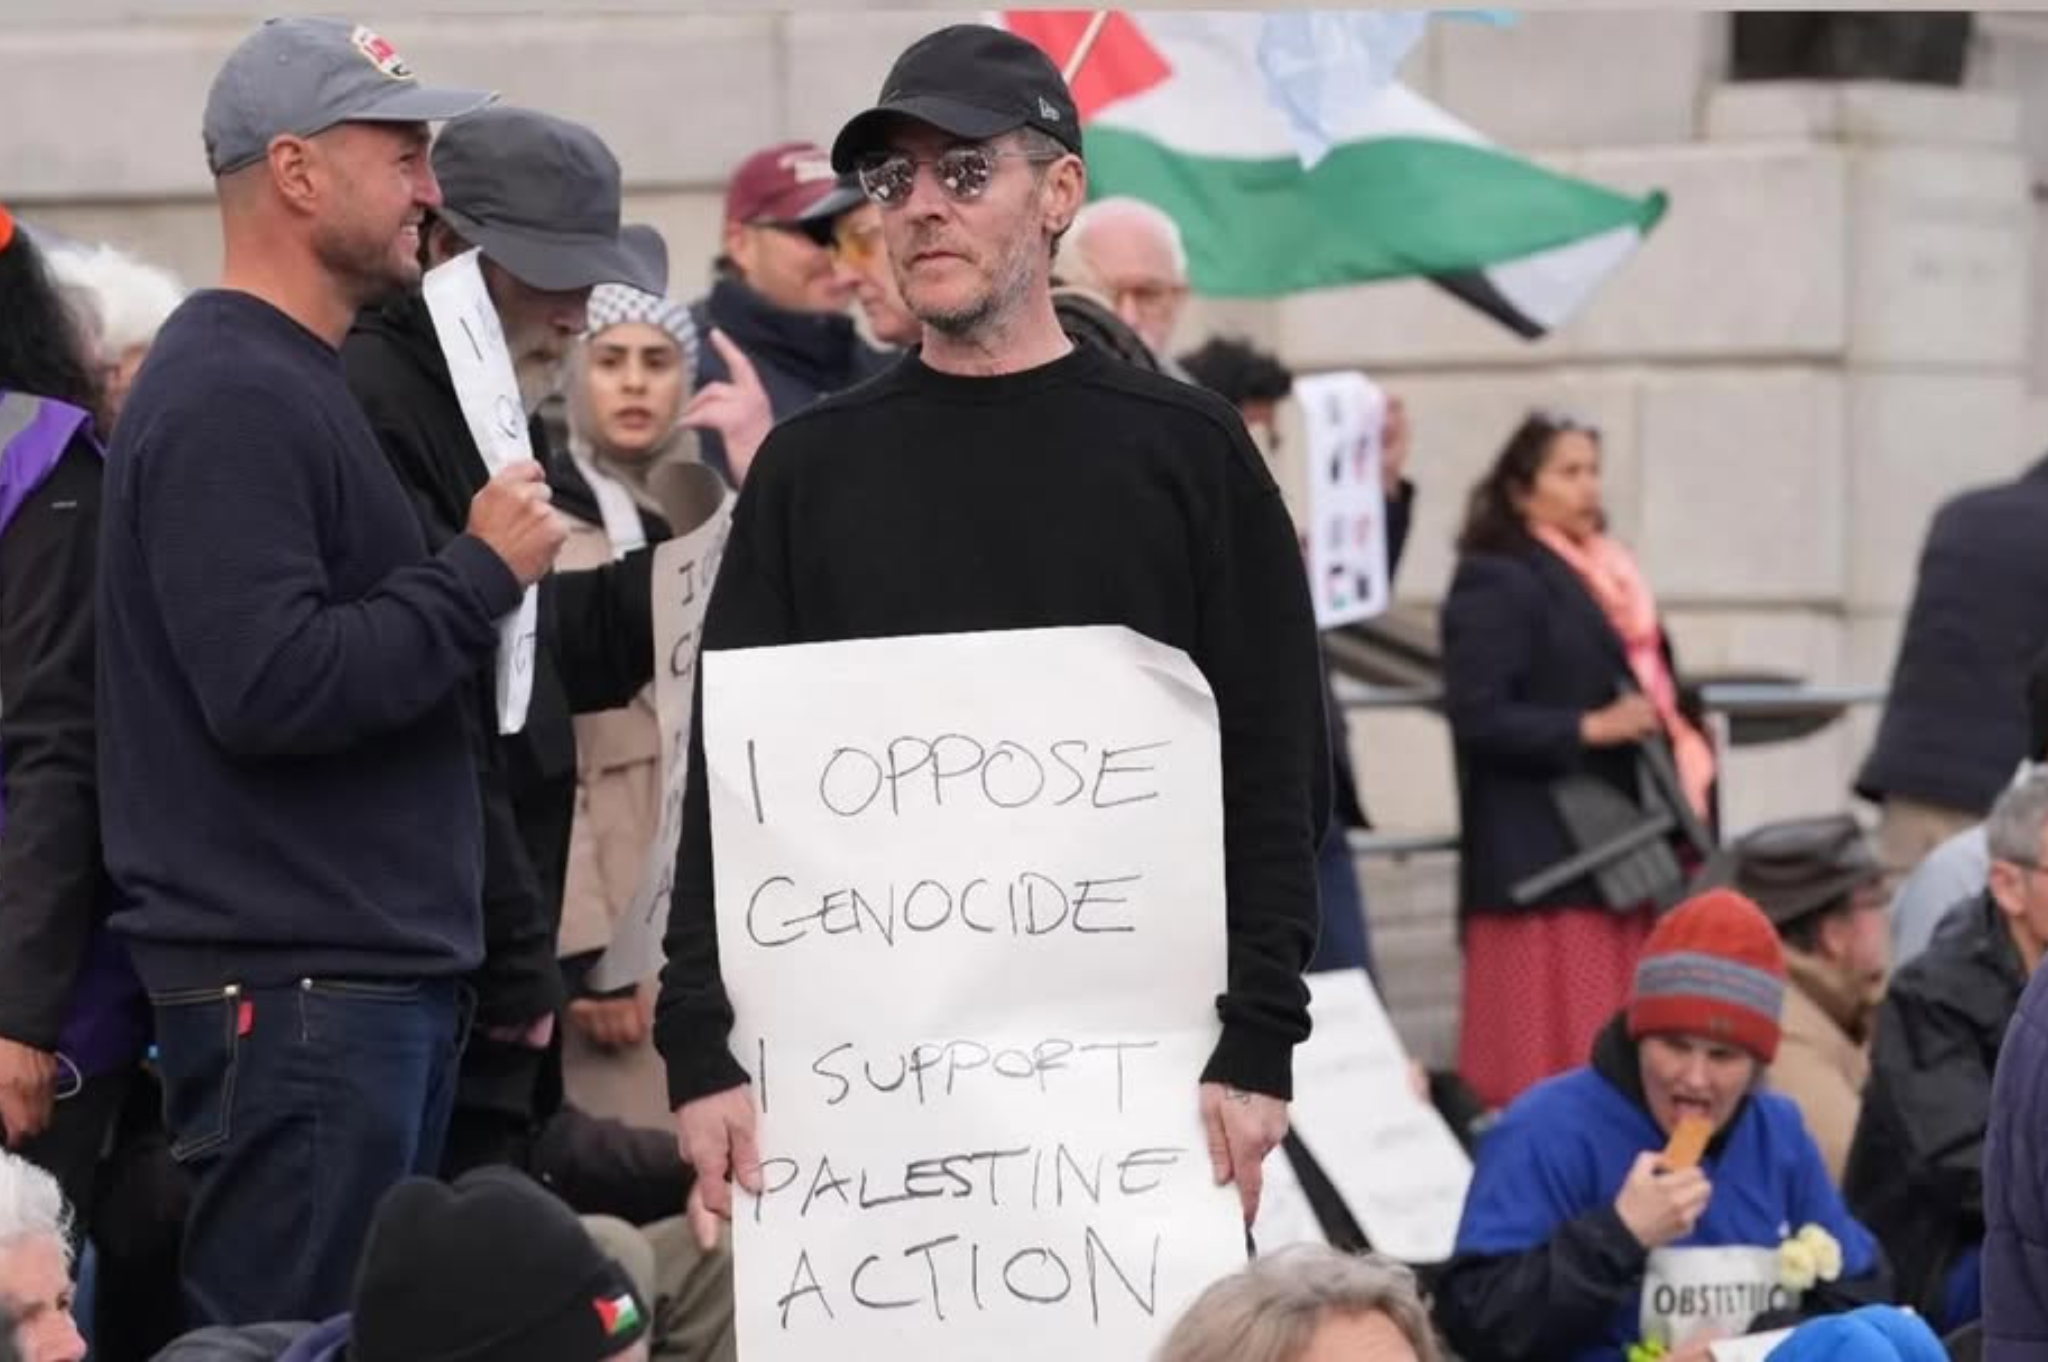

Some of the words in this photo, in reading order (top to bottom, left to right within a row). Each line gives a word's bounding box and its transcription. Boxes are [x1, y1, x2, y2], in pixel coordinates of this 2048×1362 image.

[746, 738, 765, 825] I
[818, 732, 1172, 818] OPPOSE
[745, 871, 1143, 948] GENOCIDE
[757, 1037, 769, 1114] I
[811, 1038, 1159, 1113] SUPPORT
[754, 1142, 1187, 1224] PALESTINE
[776, 1225, 1161, 1330] ACTION
